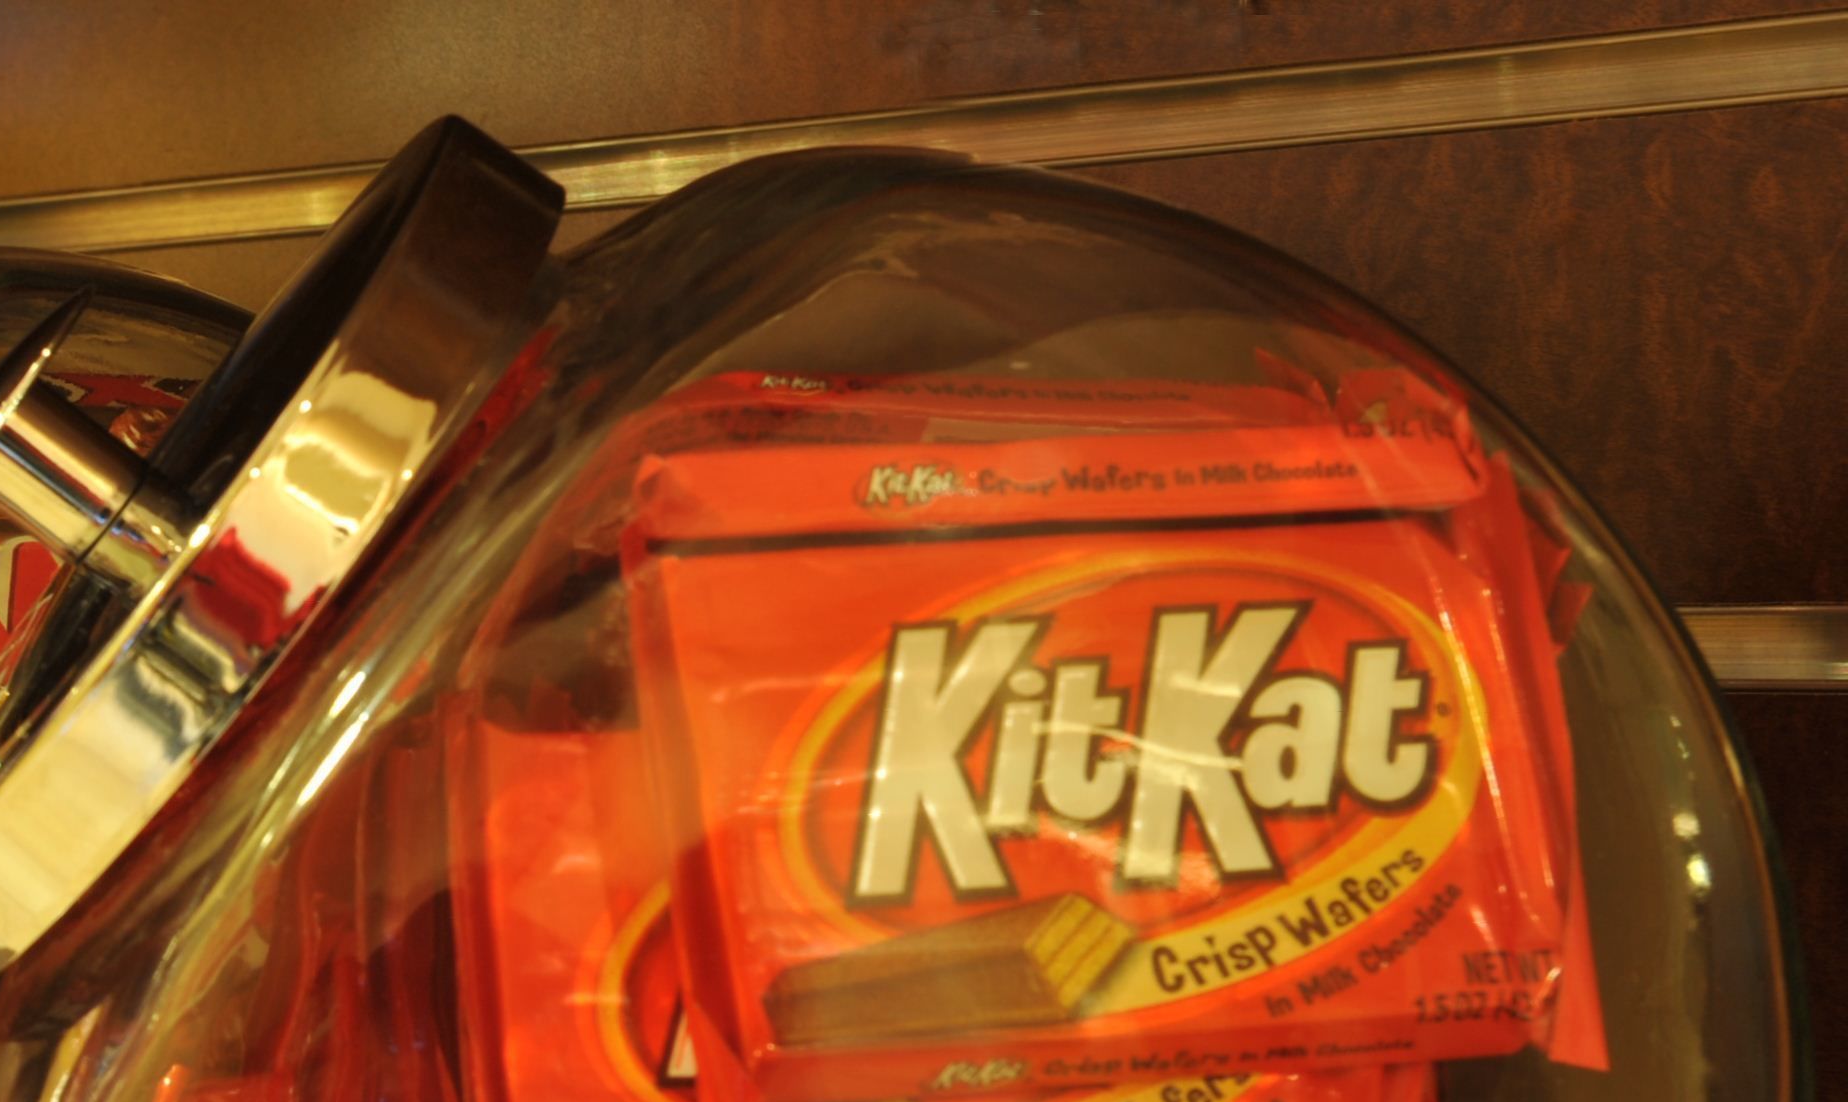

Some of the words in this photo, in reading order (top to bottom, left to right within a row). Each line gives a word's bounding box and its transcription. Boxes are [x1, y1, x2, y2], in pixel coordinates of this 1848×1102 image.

[1061, 464, 1166, 492] Wafers
[1199, 461, 1248, 486] Milk
[1253, 459, 1358, 483] Chocolate
[1151, 925, 1277, 994] Crisp
[1279, 848, 1427, 949] Wafers
[1296, 965, 1359, 1007] Milk
[1357, 883, 1463, 975] Chocolate
